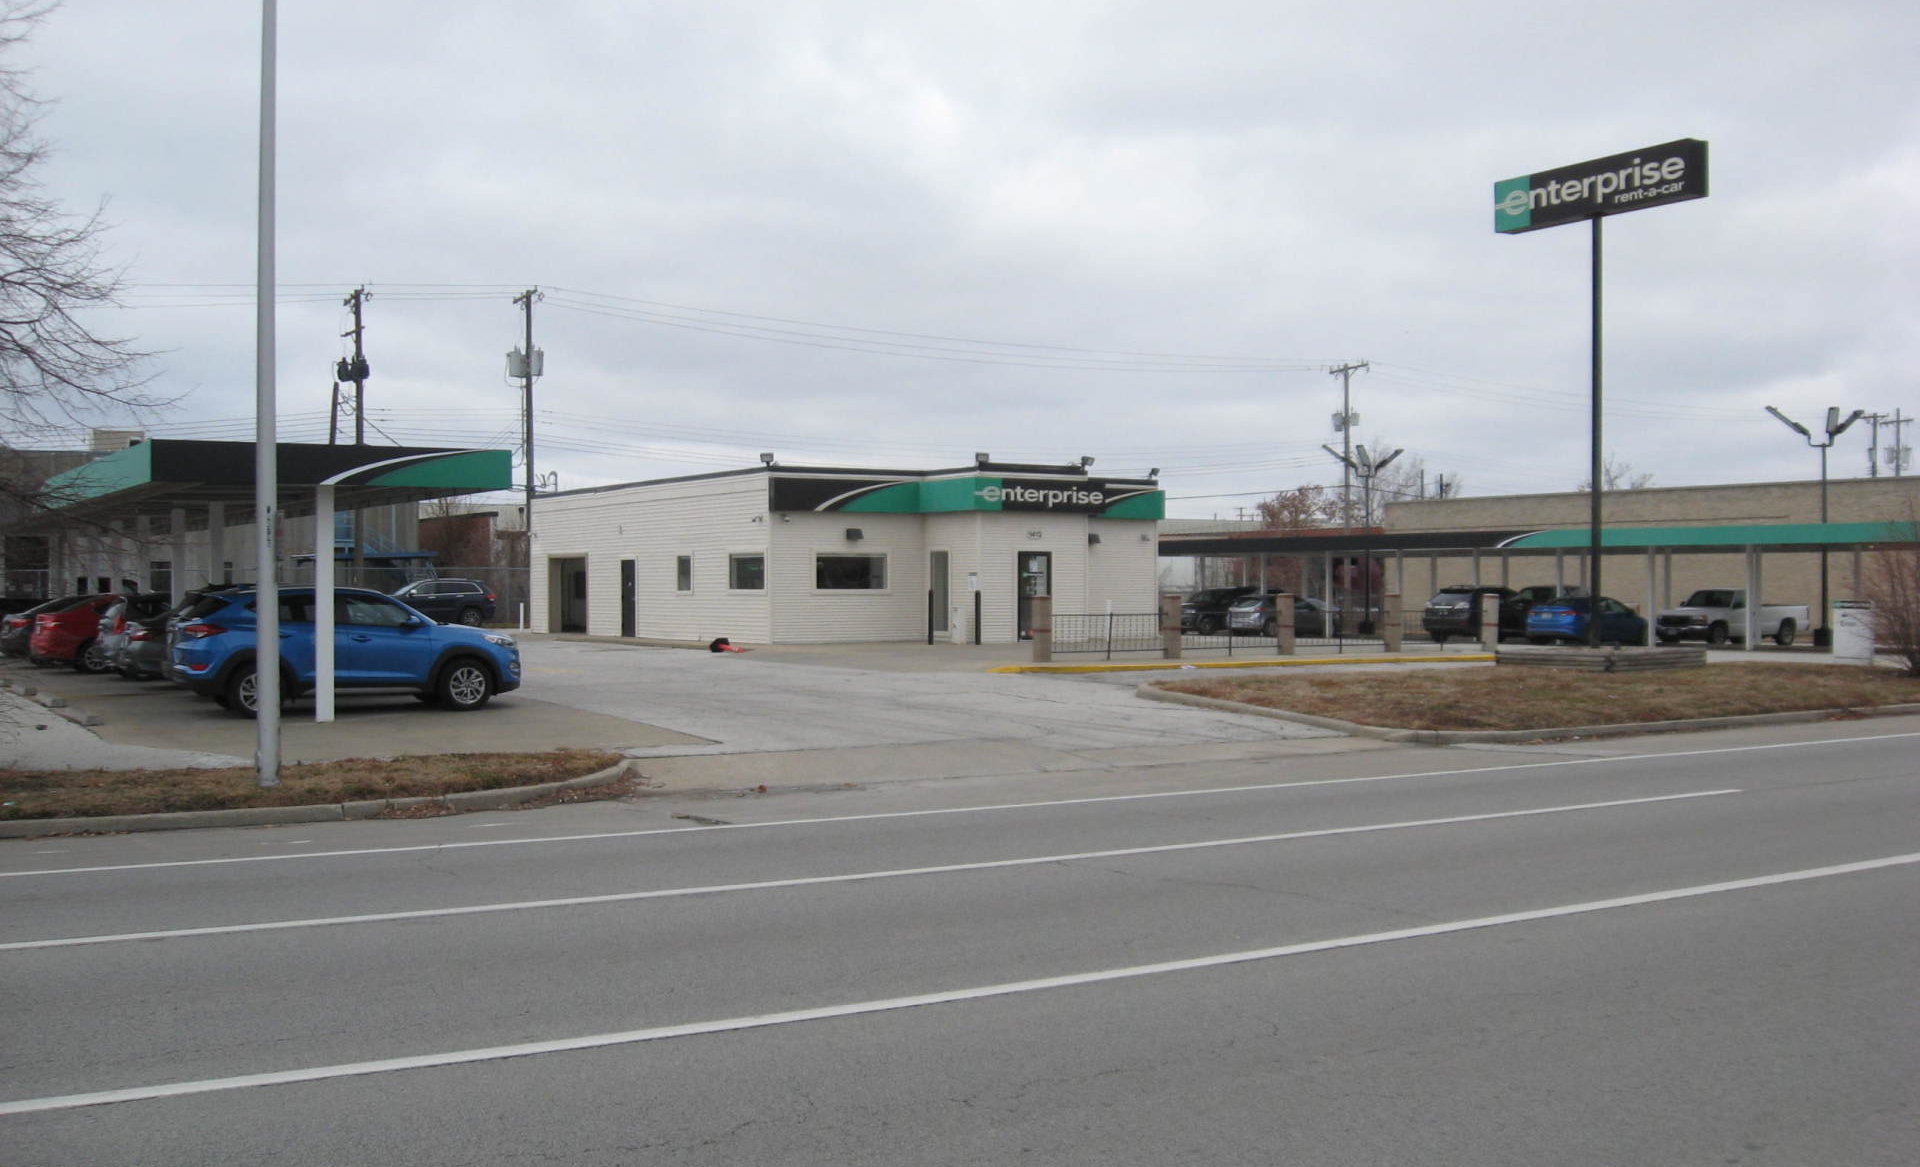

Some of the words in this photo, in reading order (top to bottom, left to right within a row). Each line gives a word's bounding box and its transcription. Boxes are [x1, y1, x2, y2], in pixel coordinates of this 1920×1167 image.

[1496, 156, 1685, 215] enterprise
[1614, 181, 1685, 204] rent-a-car
[975, 486, 1103, 507] enterprise
